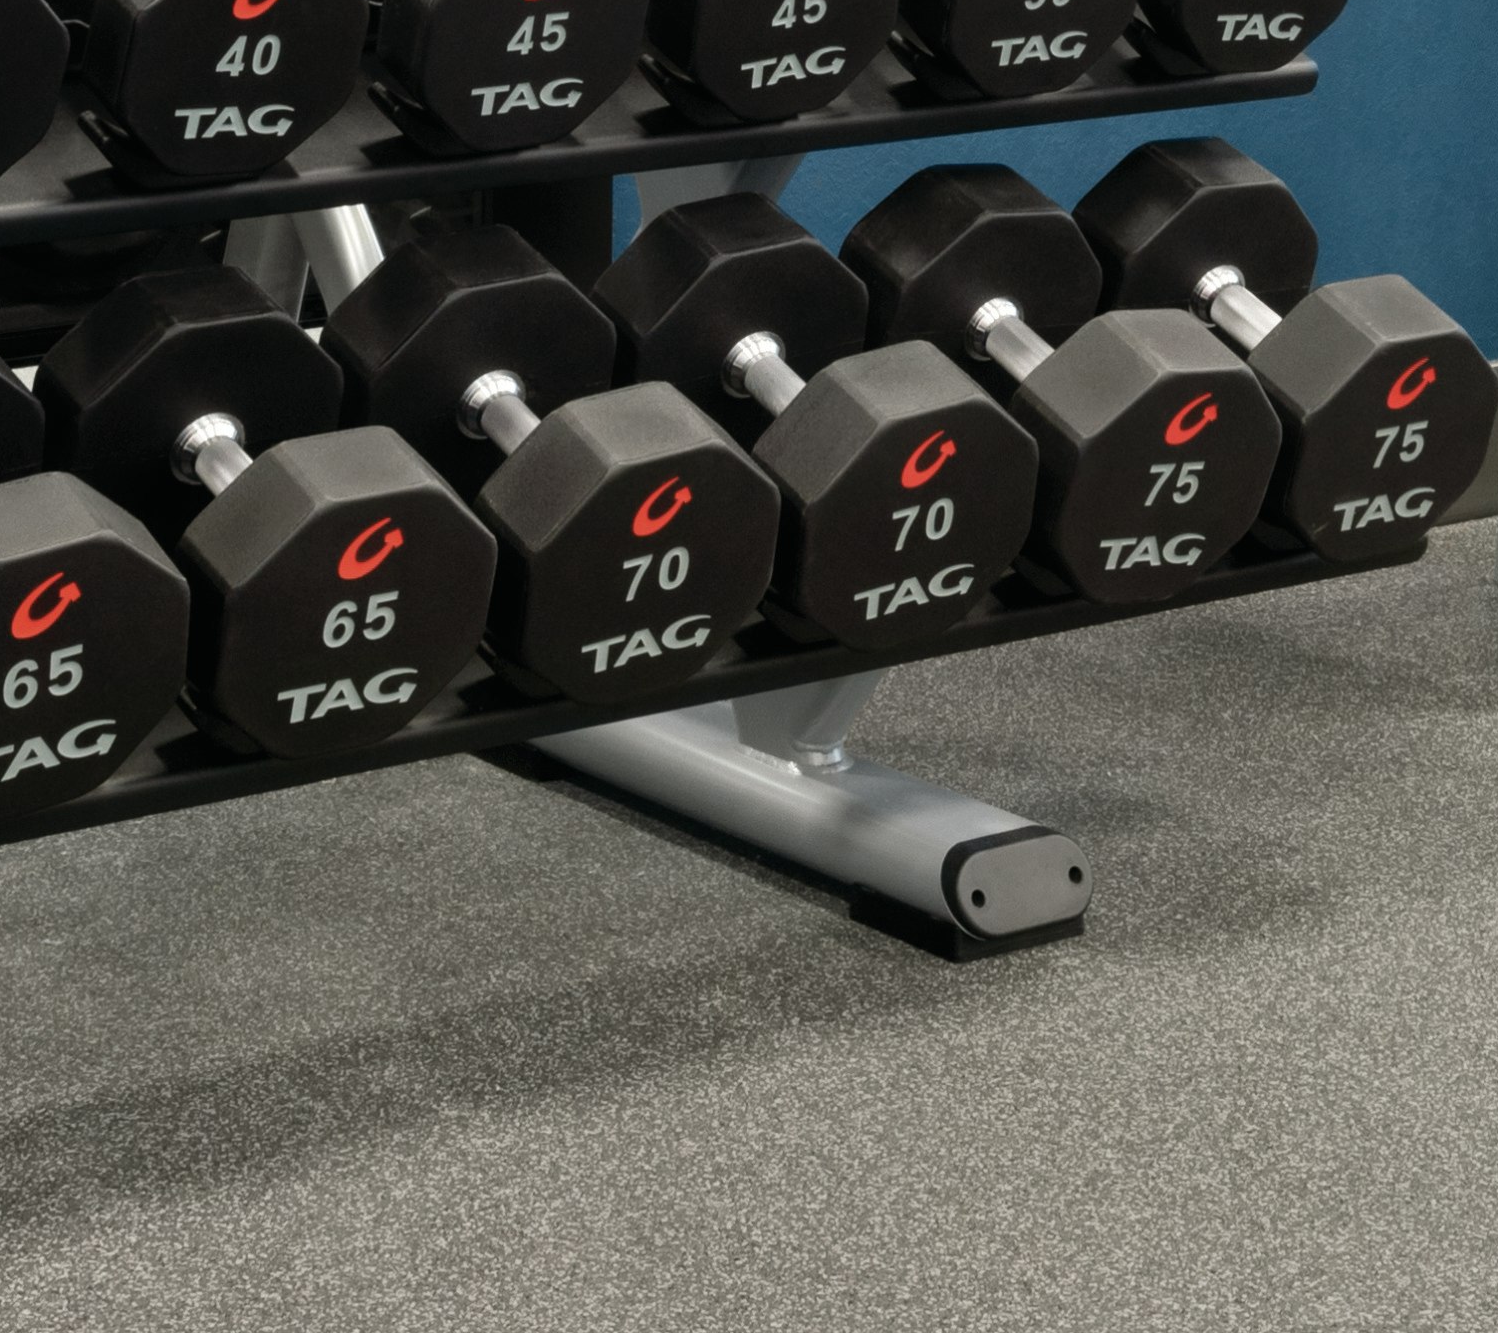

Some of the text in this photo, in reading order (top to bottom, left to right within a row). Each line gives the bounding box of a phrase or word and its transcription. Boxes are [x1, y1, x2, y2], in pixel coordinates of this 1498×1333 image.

[506, 11, 570, 56] 45
[990, 30, 1088, 67] TAG
[1216, 12, 1304, 42] TAG
[215, 34, 281, 77] 40
[740, 45, 846, 90] TAG
[470, 77, 584, 117] TAG
[174, 104, 295, 140] TAG
[1372, 420, 1429, 469] 75
[1144, 461, 1205, 507] 75
[891, 497, 954, 552] 70
[1333, 486, 1436, 533] TAG
[622, 546, 690, 603] 70
[1099, 532, 1206, 571] TAG
[853, 563, 975, 621] TAG
[322, 590, 399, 649] 65
[581, 614, 712, 674] TAG
[2, 643, 84, 710] 65
[277, 667, 418, 724] TAG
